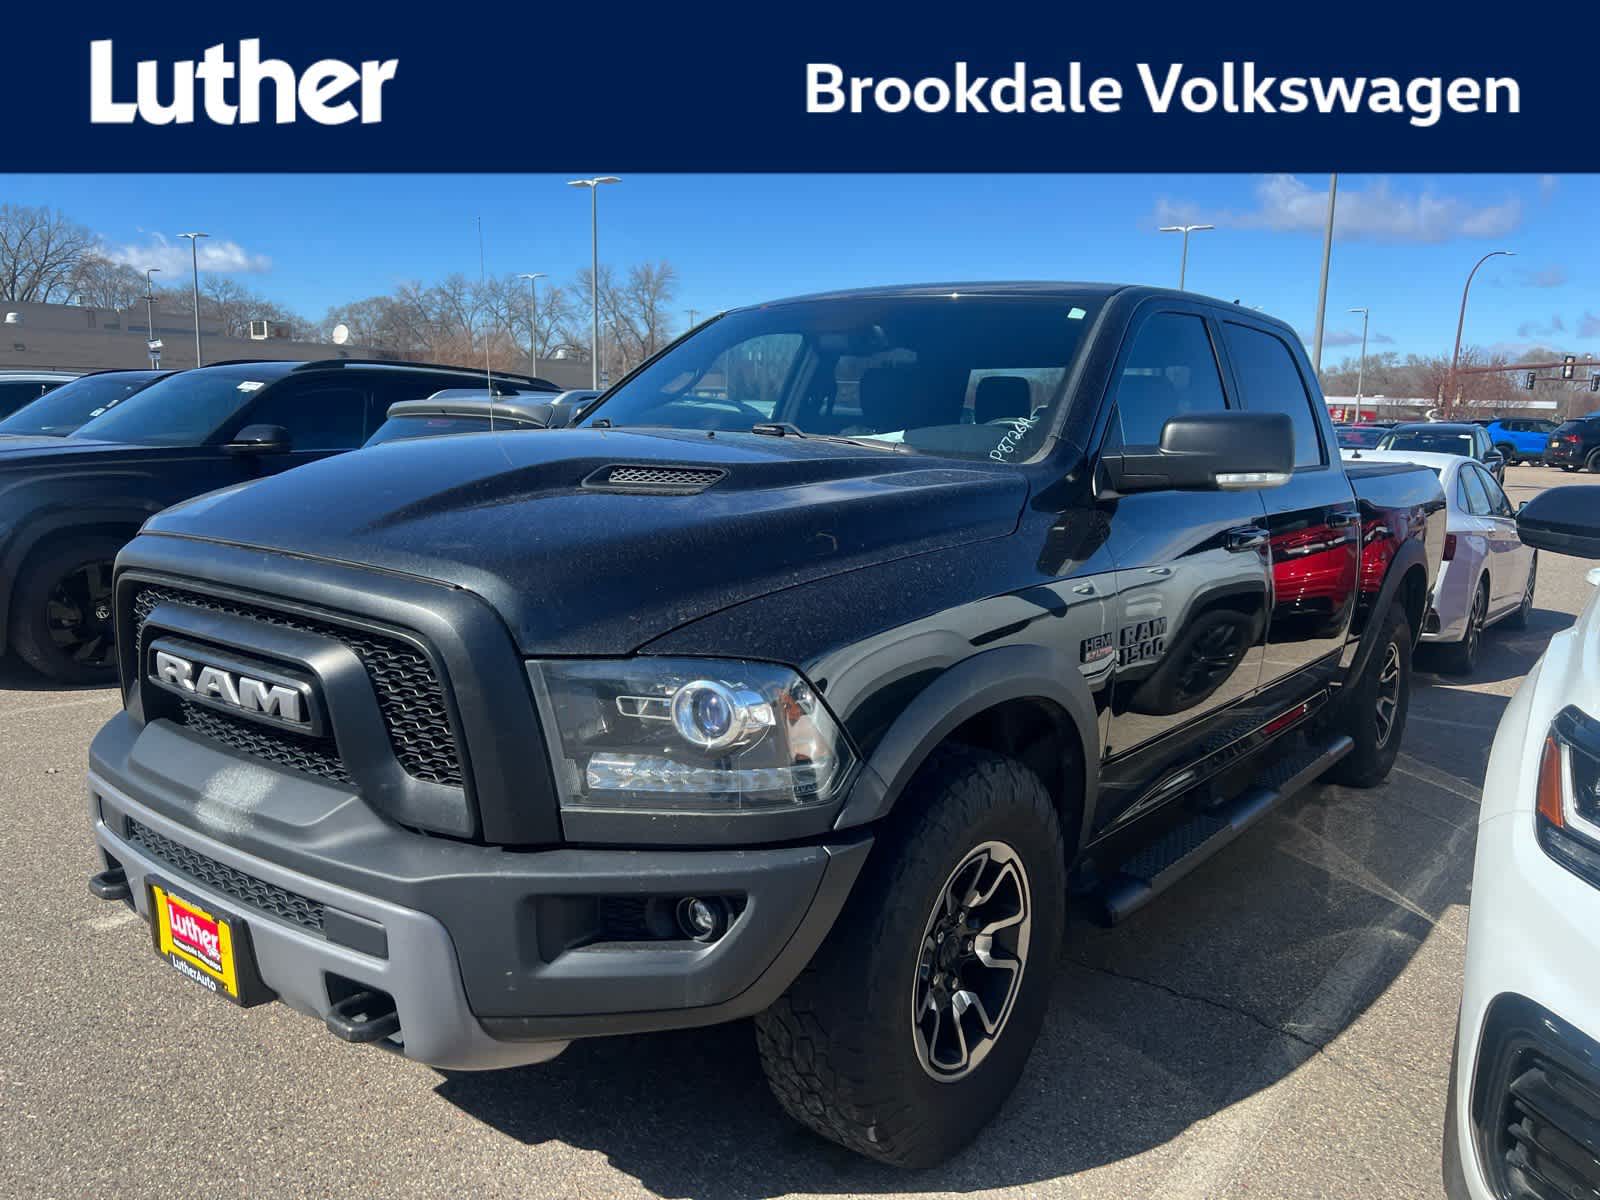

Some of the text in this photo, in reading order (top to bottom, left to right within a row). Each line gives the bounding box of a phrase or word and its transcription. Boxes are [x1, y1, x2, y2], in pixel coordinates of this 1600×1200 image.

[1120, 616, 1168, 647] RAM
[1120, 636, 1167, 666] 1500
[156, 650, 302, 721] RAM
[168, 903, 219, 950] Luther
[171, 955, 217, 991] LutherAuto
